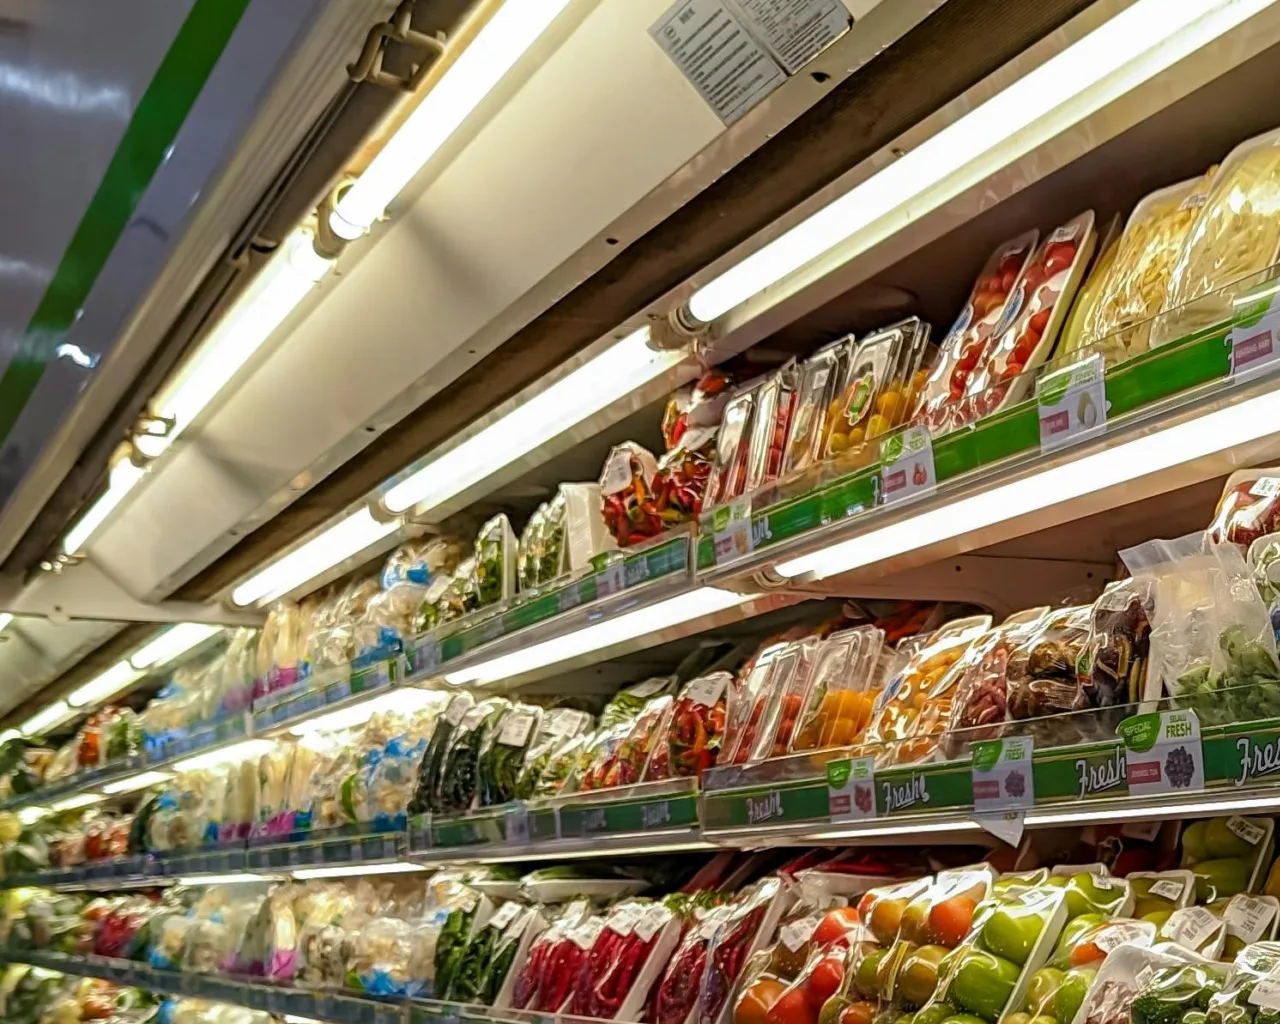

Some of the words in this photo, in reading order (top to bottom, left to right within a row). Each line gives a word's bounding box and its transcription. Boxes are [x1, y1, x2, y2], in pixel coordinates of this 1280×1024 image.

[1166, 722, 1192, 739] FRESH
[883, 772, 920, 817] Fresh
[1076, 746, 1126, 800] Fresh
